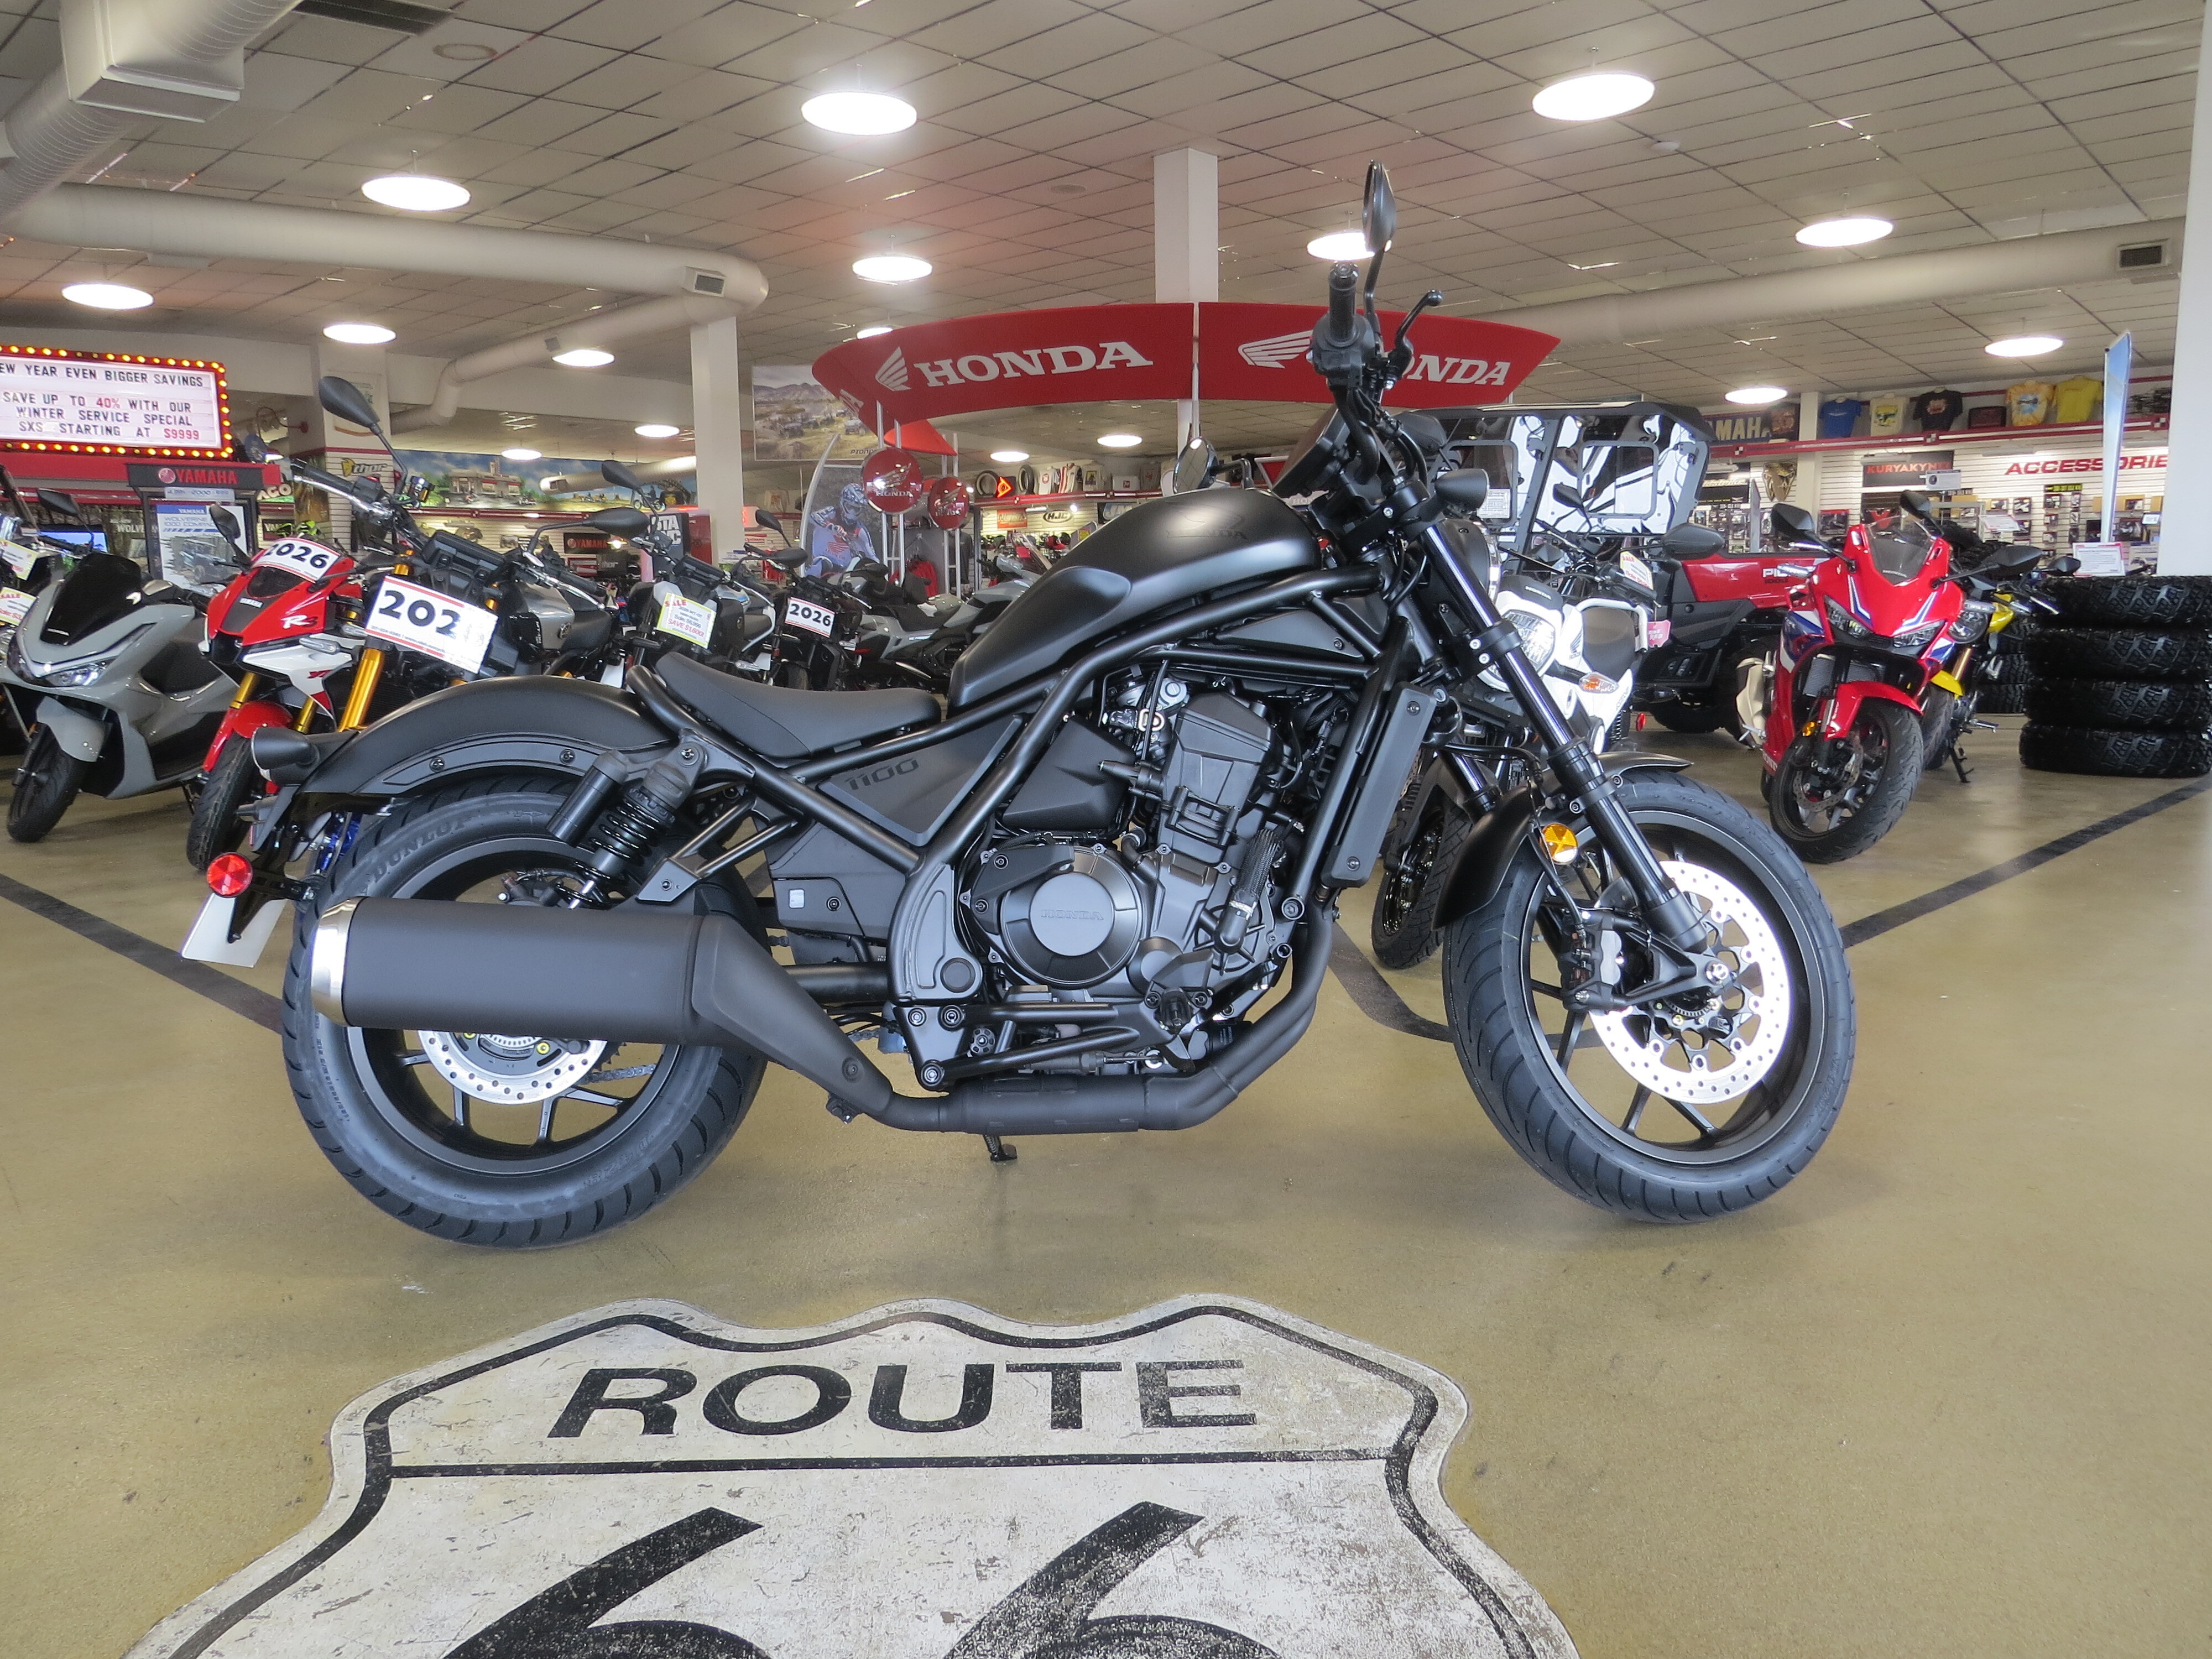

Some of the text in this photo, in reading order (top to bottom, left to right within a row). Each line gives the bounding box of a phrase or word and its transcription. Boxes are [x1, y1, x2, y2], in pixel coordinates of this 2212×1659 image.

[914, 341, 1154, 388] HONDA
[1402, 354, 1511, 386] NDA
[24, 364, 58, 377] YEAR
[66, 367, 97, 379] EVEN
[105, 371, 148, 383] BIGGER
[154, 374, 203, 387] SAVINGS
[3, 392, 191, 413] SAVE UP TO 40% WITH OUR
[16, 406, 193, 426] WINTER SERVICE SPECIAL
[19, 421, 43, 433] SXS
[59, 423, 121, 437] STARTING
[136, 427, 151, 438] AT
[175, 469, 239, 484] YAMAHA
[576, 539, 608, 548] YAMAHA
[263, 542, 330, 569] 2026
[280, 614, 319, 630] R3
[668, 619, 685, 629] SAVE
[789, 603, 831, 627] 2026
[843, 757, 919, 791] 1100
[1040, 908, 1104, 921] HONDA
[547, 1359, 1256, 1438] ROUTE
